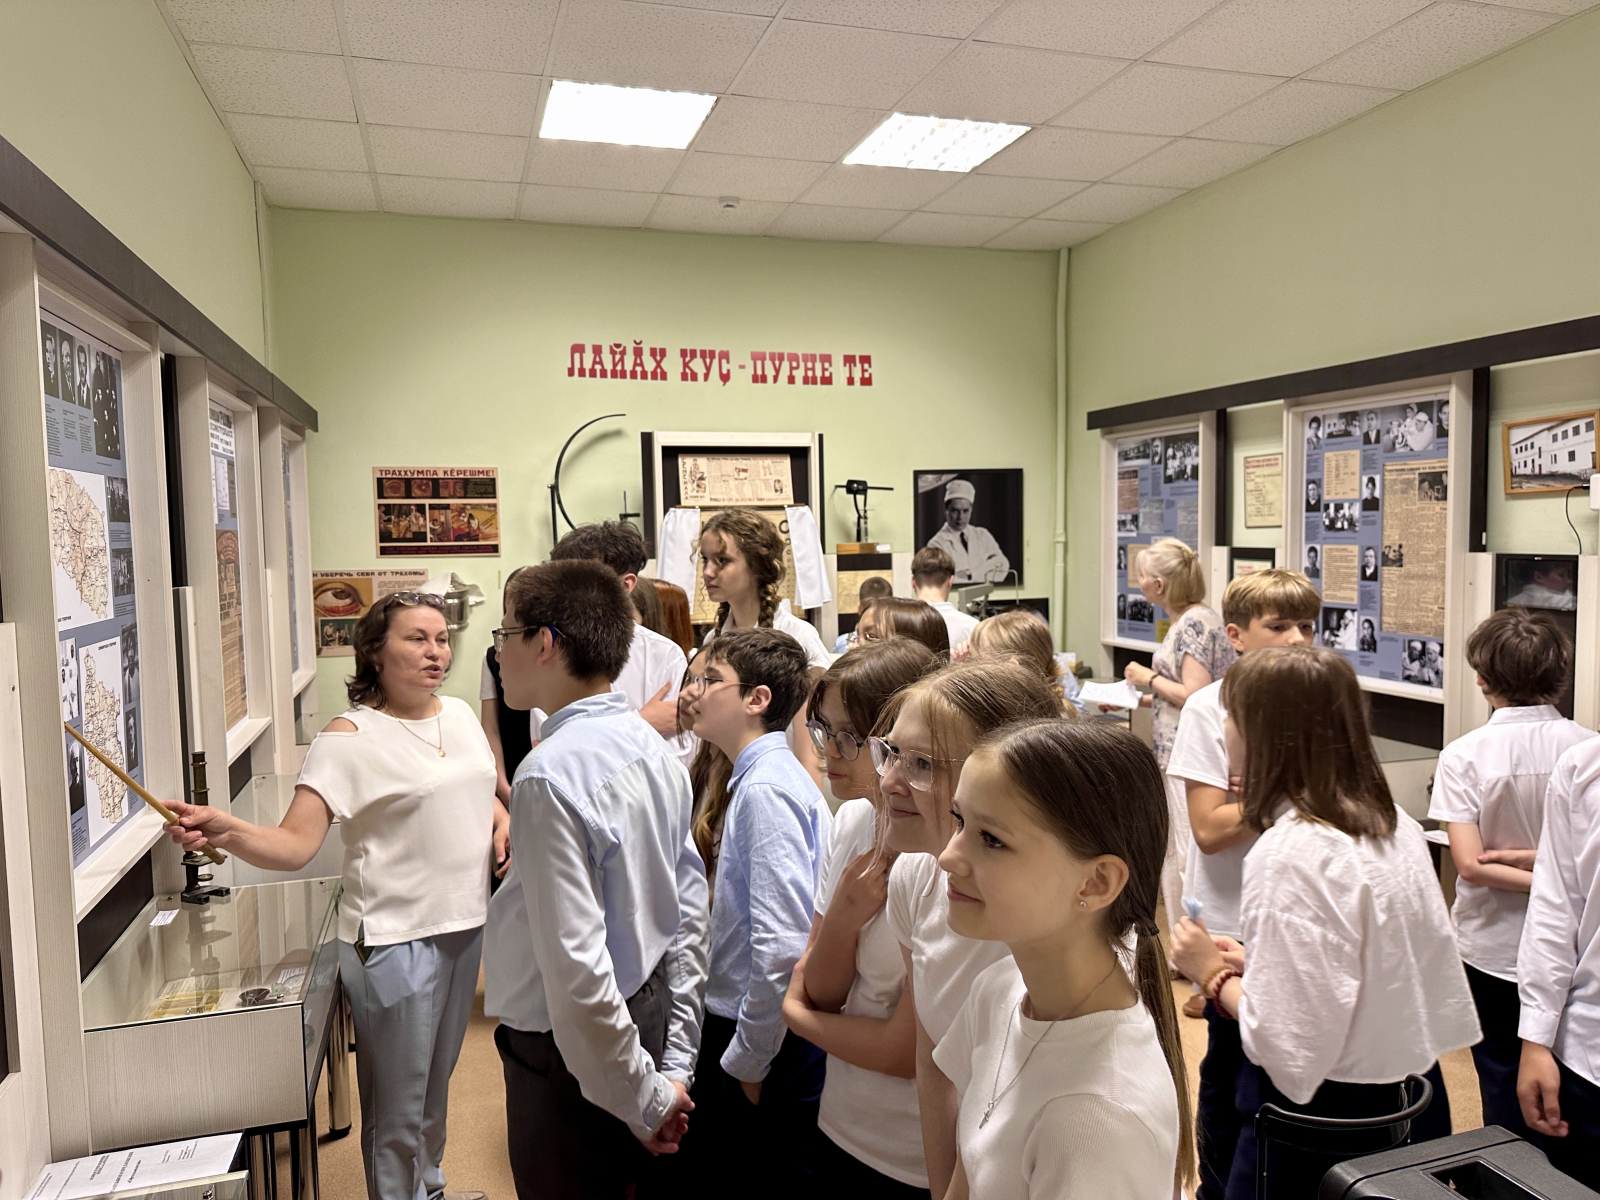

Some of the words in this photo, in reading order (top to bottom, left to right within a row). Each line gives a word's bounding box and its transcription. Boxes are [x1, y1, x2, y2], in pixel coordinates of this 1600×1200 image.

[567, 339, 668, 381] ЛАЙӐХ
[749, 350, 833, 386] ПУРНЕ
[842, 354, 873, 387] ТЕ
